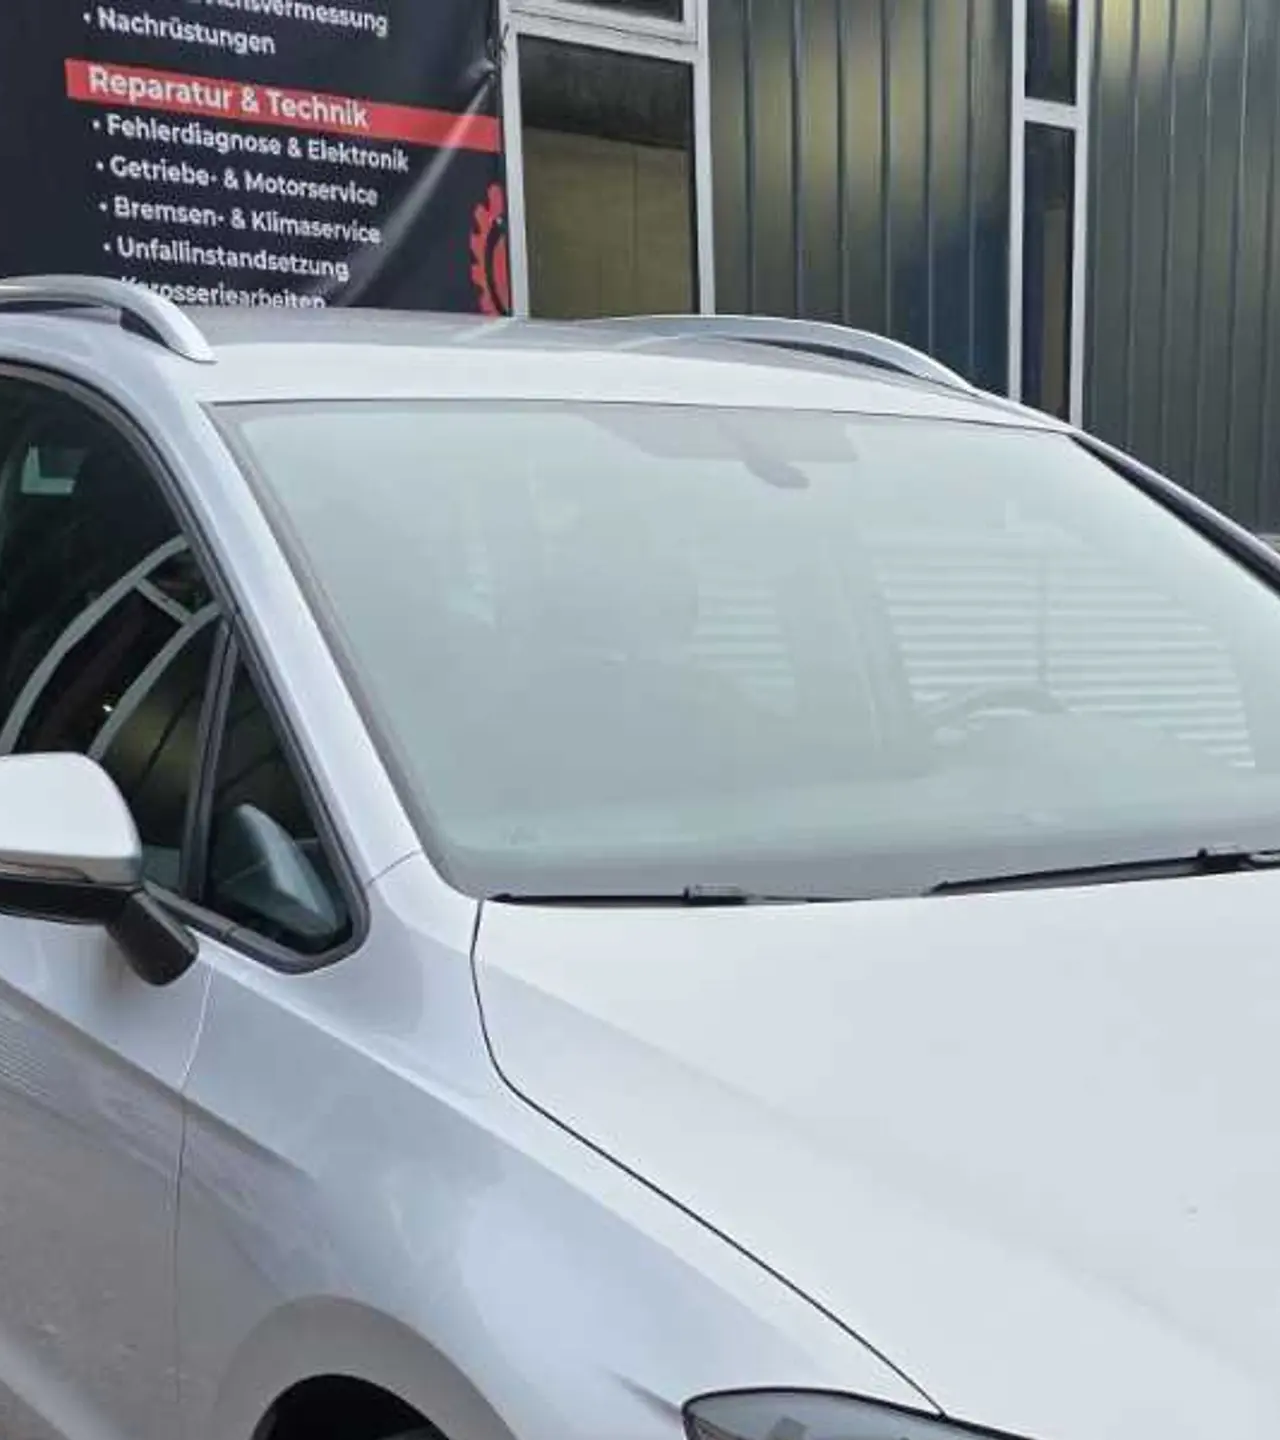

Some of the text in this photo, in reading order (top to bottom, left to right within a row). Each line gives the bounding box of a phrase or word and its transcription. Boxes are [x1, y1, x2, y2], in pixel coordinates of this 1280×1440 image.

[97, 5, 276, 54] Nachrüstungen
[87, 65, 370, 128] Reparatur & Technik
[105, 113, 410, 172] Fehlerdiagnose & Elektronik
[109, 155, 379, 206] Getriebe- & Motorservice
[113, 196, 382, 243] Bremsen- & Klimaservice
[116, 235, 350, 282] Unfallinstandsetzung
